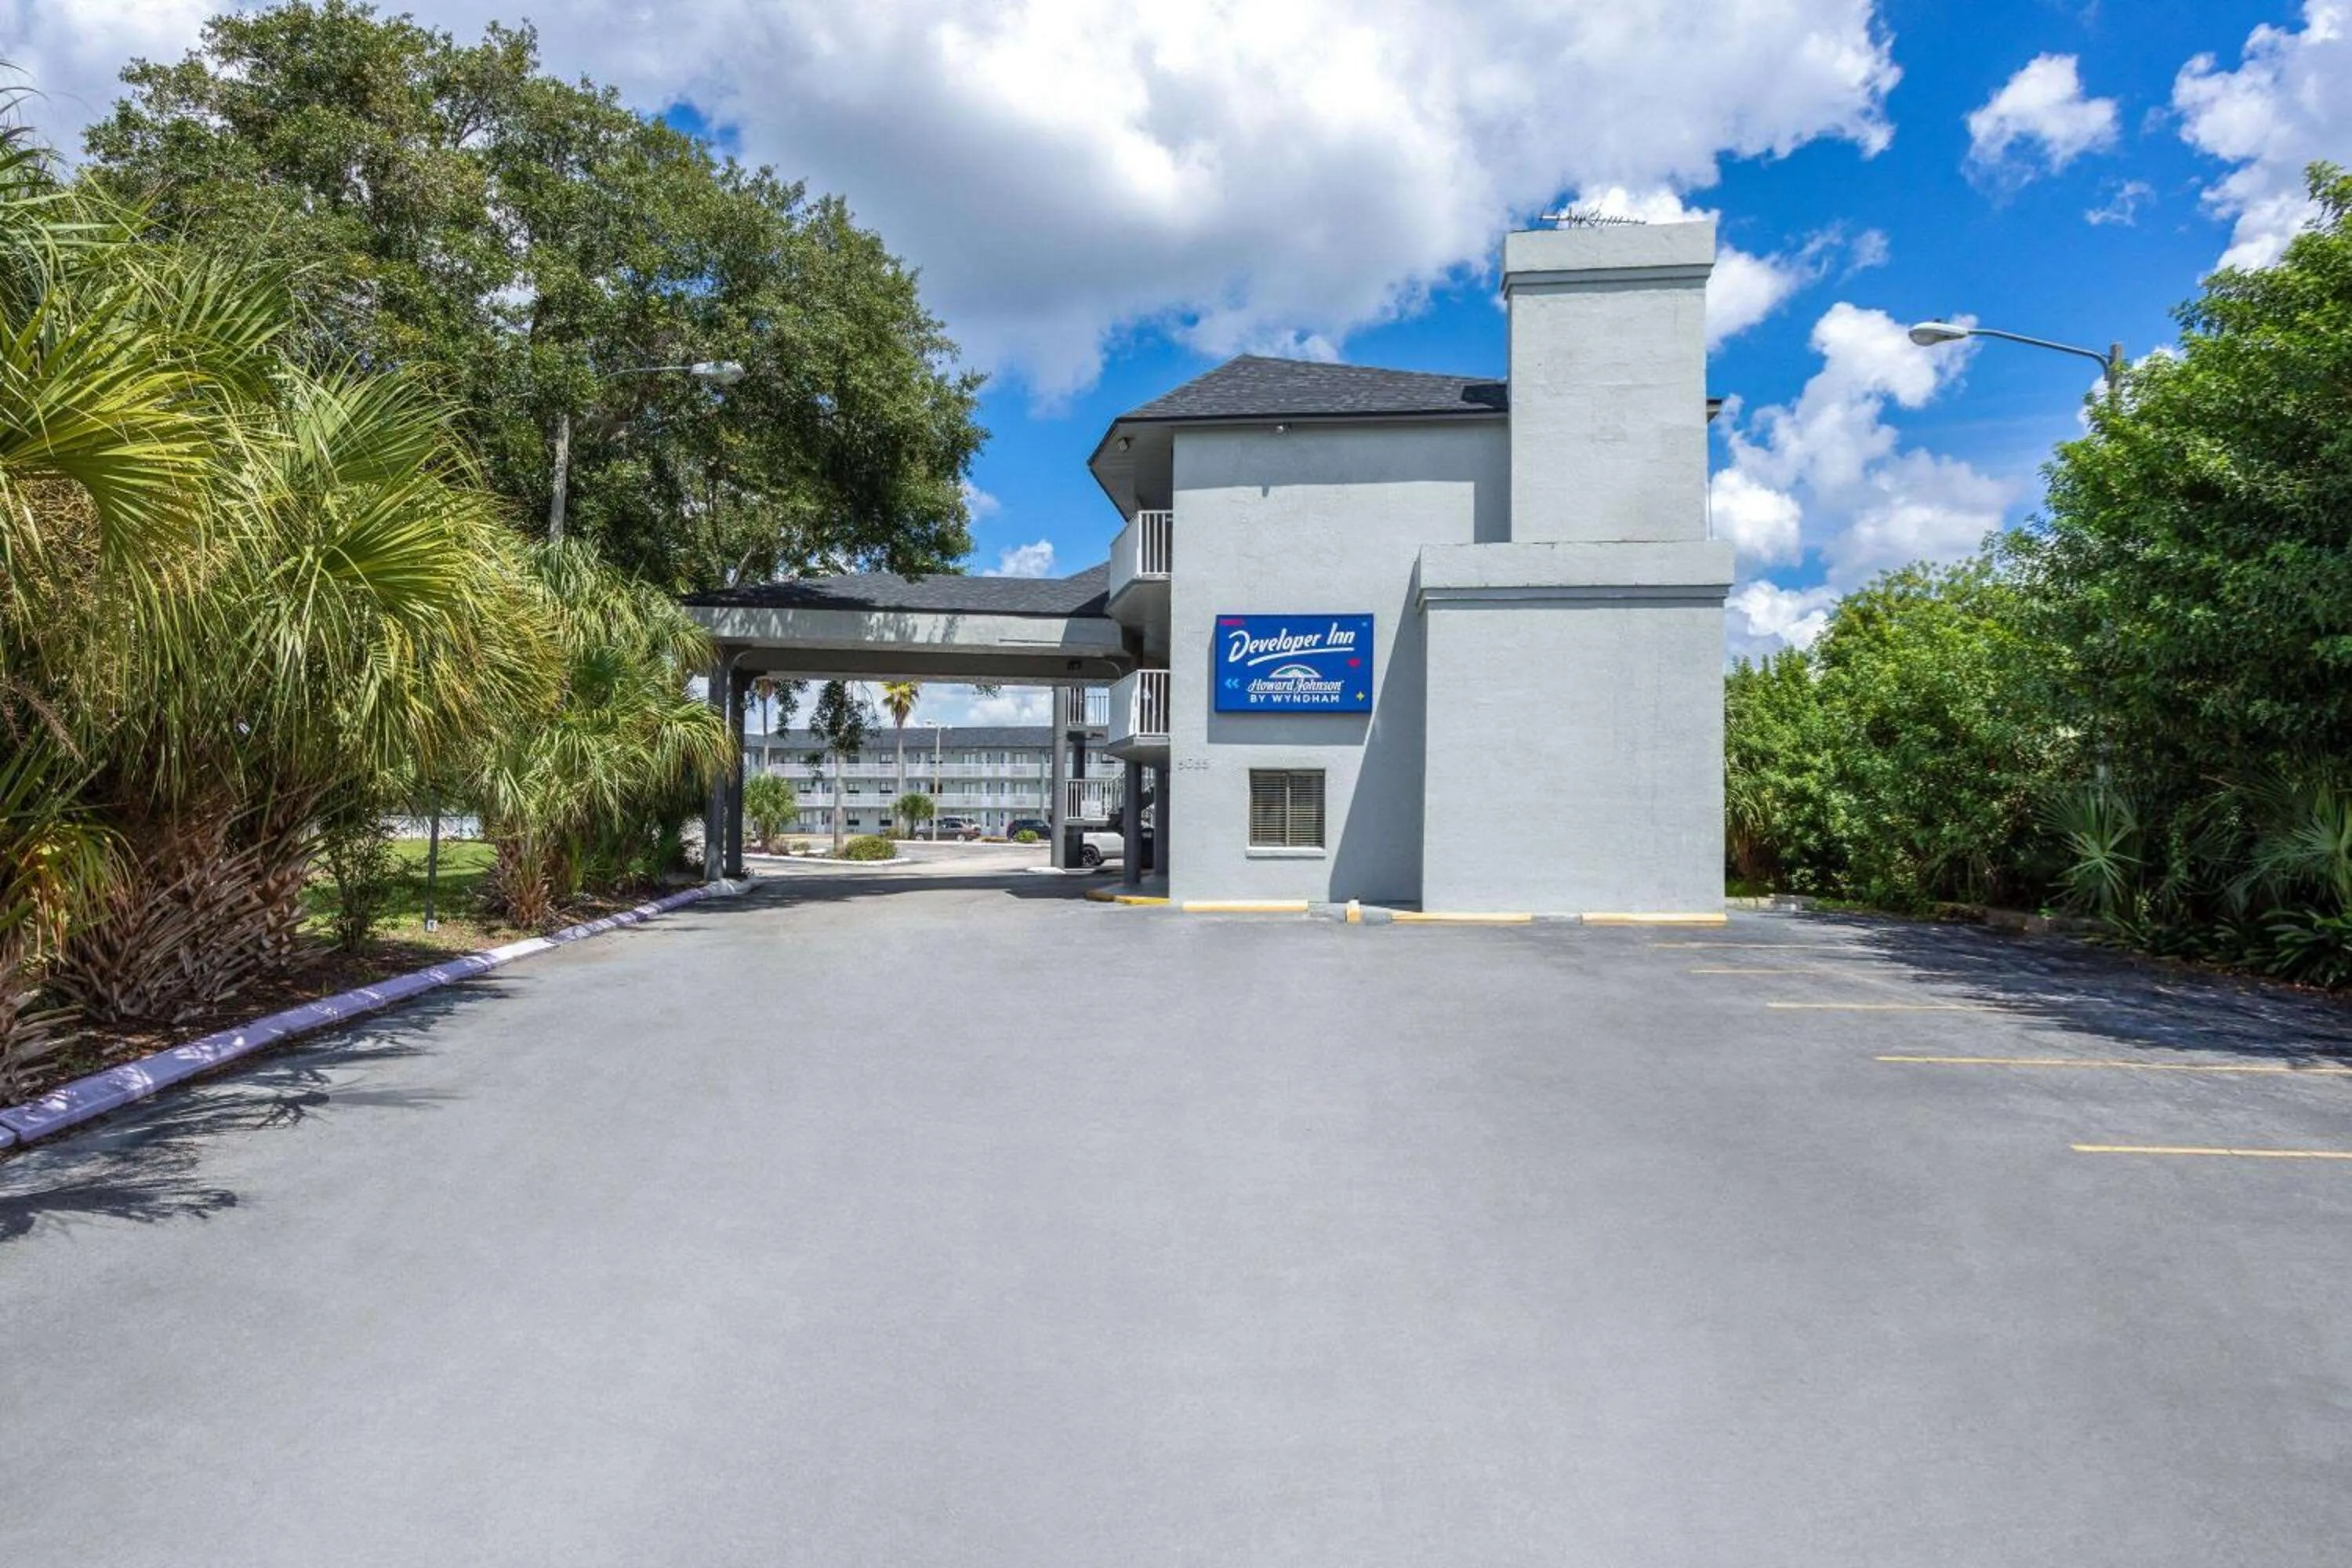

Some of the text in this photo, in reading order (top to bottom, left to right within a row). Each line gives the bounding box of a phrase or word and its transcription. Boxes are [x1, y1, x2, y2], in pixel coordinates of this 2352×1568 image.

[1229, 622, 1356, 662] Developer Inn
[1247, 677, 1341, 694] Howard Johnson
[1250, 695, 1340, 703] BY WYNDHAM
